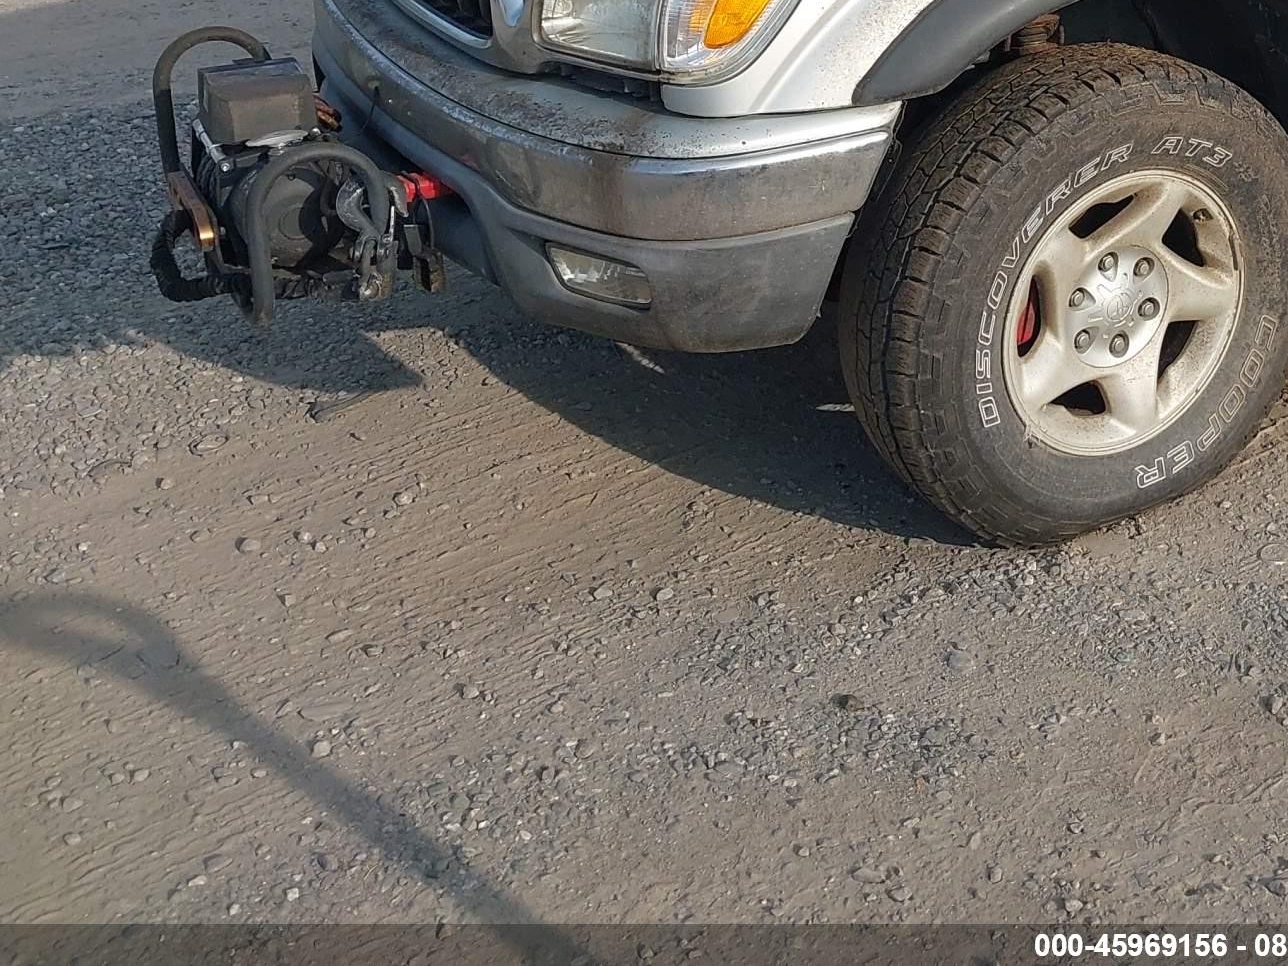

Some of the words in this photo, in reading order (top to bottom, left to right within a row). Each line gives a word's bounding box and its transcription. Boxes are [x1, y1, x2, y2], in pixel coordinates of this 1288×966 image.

[975, 142, 1133, 429] DISCOVERER
[1151, 135, 1233, 168] AT3
[1134, 314, 1278, 489] COOPER
